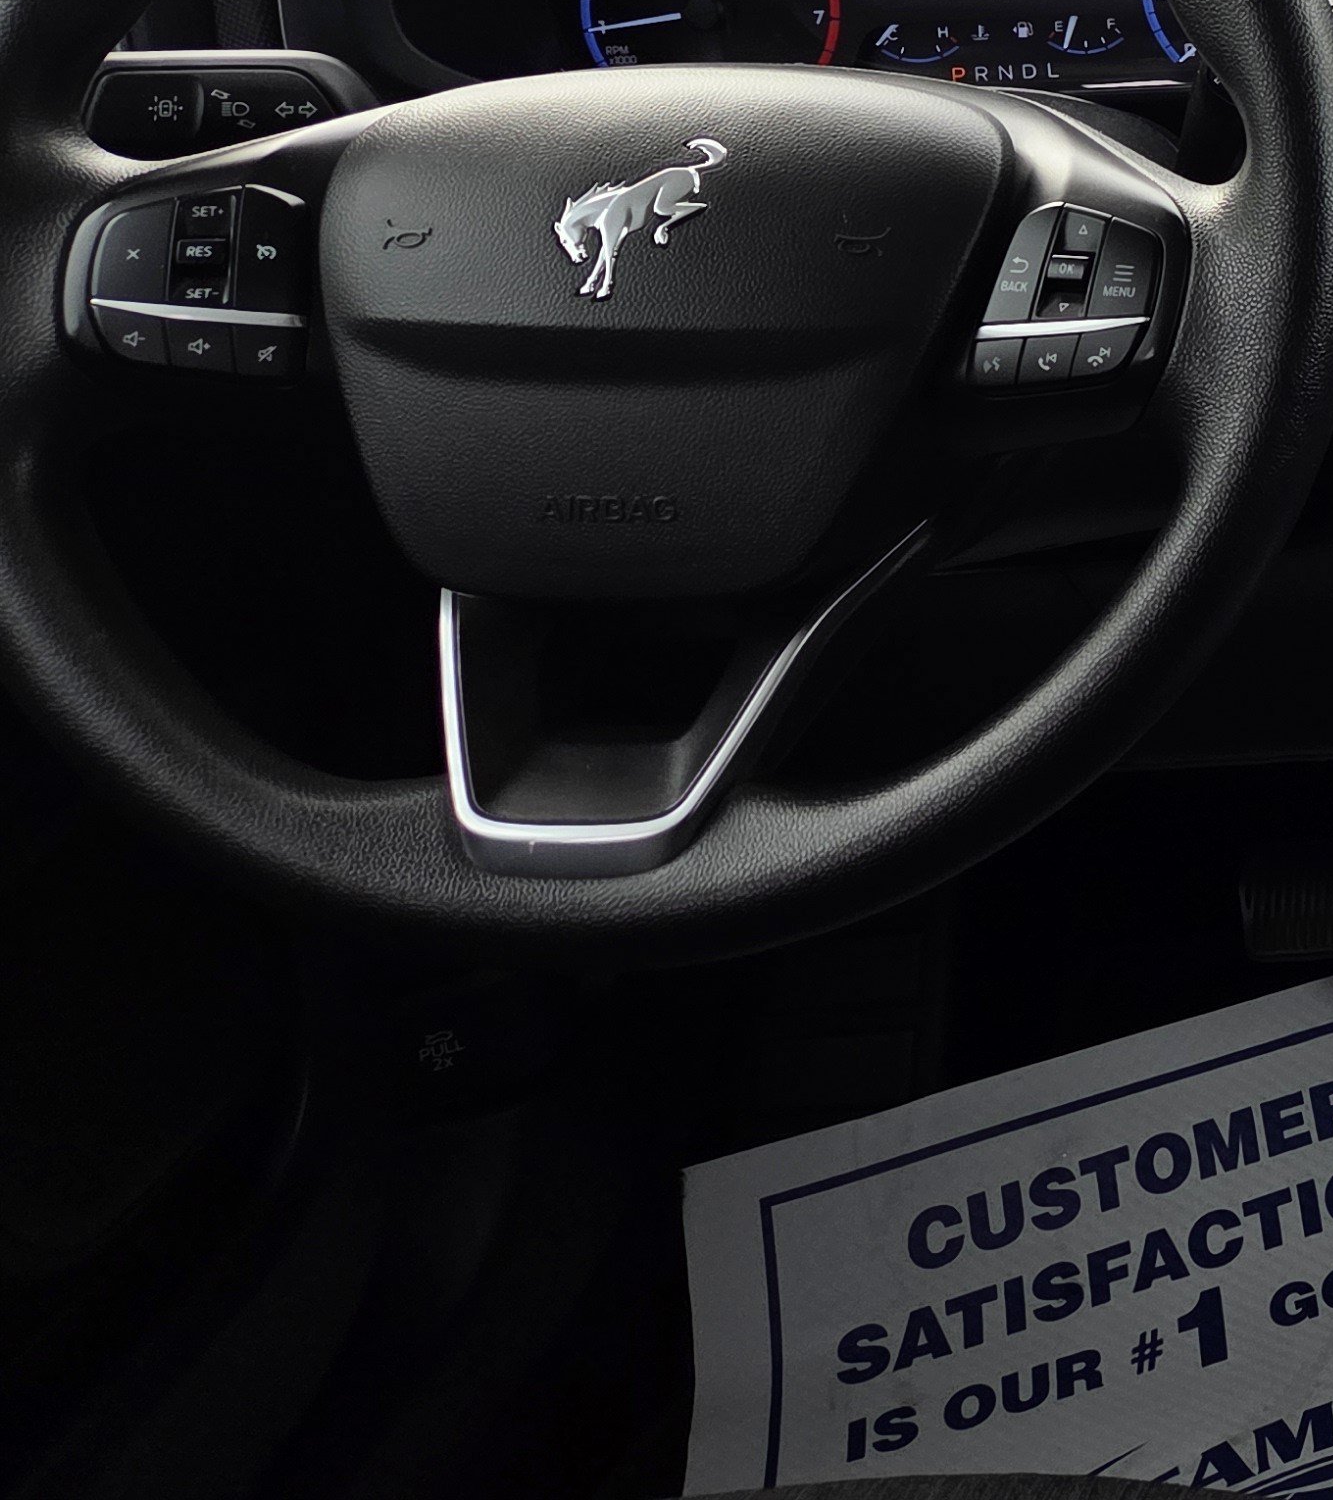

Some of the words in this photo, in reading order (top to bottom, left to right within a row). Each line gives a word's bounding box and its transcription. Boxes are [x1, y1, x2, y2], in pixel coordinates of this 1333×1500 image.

[812, 9, 825, 25] 7
[1054, 20, 1064, 32] E
[1106, 18, 1116, 30] F
[937, 26, 949, 39] H
[605, 44, 630, 56] RPM
[951, 66, 966, 81] P
[974, 65, 989, 81] R
[997, 65, 1014, 80] N
[1022, 63, 1038, 79] D
[1046, 62, 1060, 79] L
[185, 245, 213, 257] RES
[1060, 264, 1075, 275] OK
[1000, 281, 1028, 292] BACK
[1102, 285, 1136, 298] MENU
[541, 496, 677, 522] AIRBAG
[419, 1040, 467, 1062] PULL
[846, 1406, 920, 1463] IS
[943, 1349, 1105, 1431] OUR
